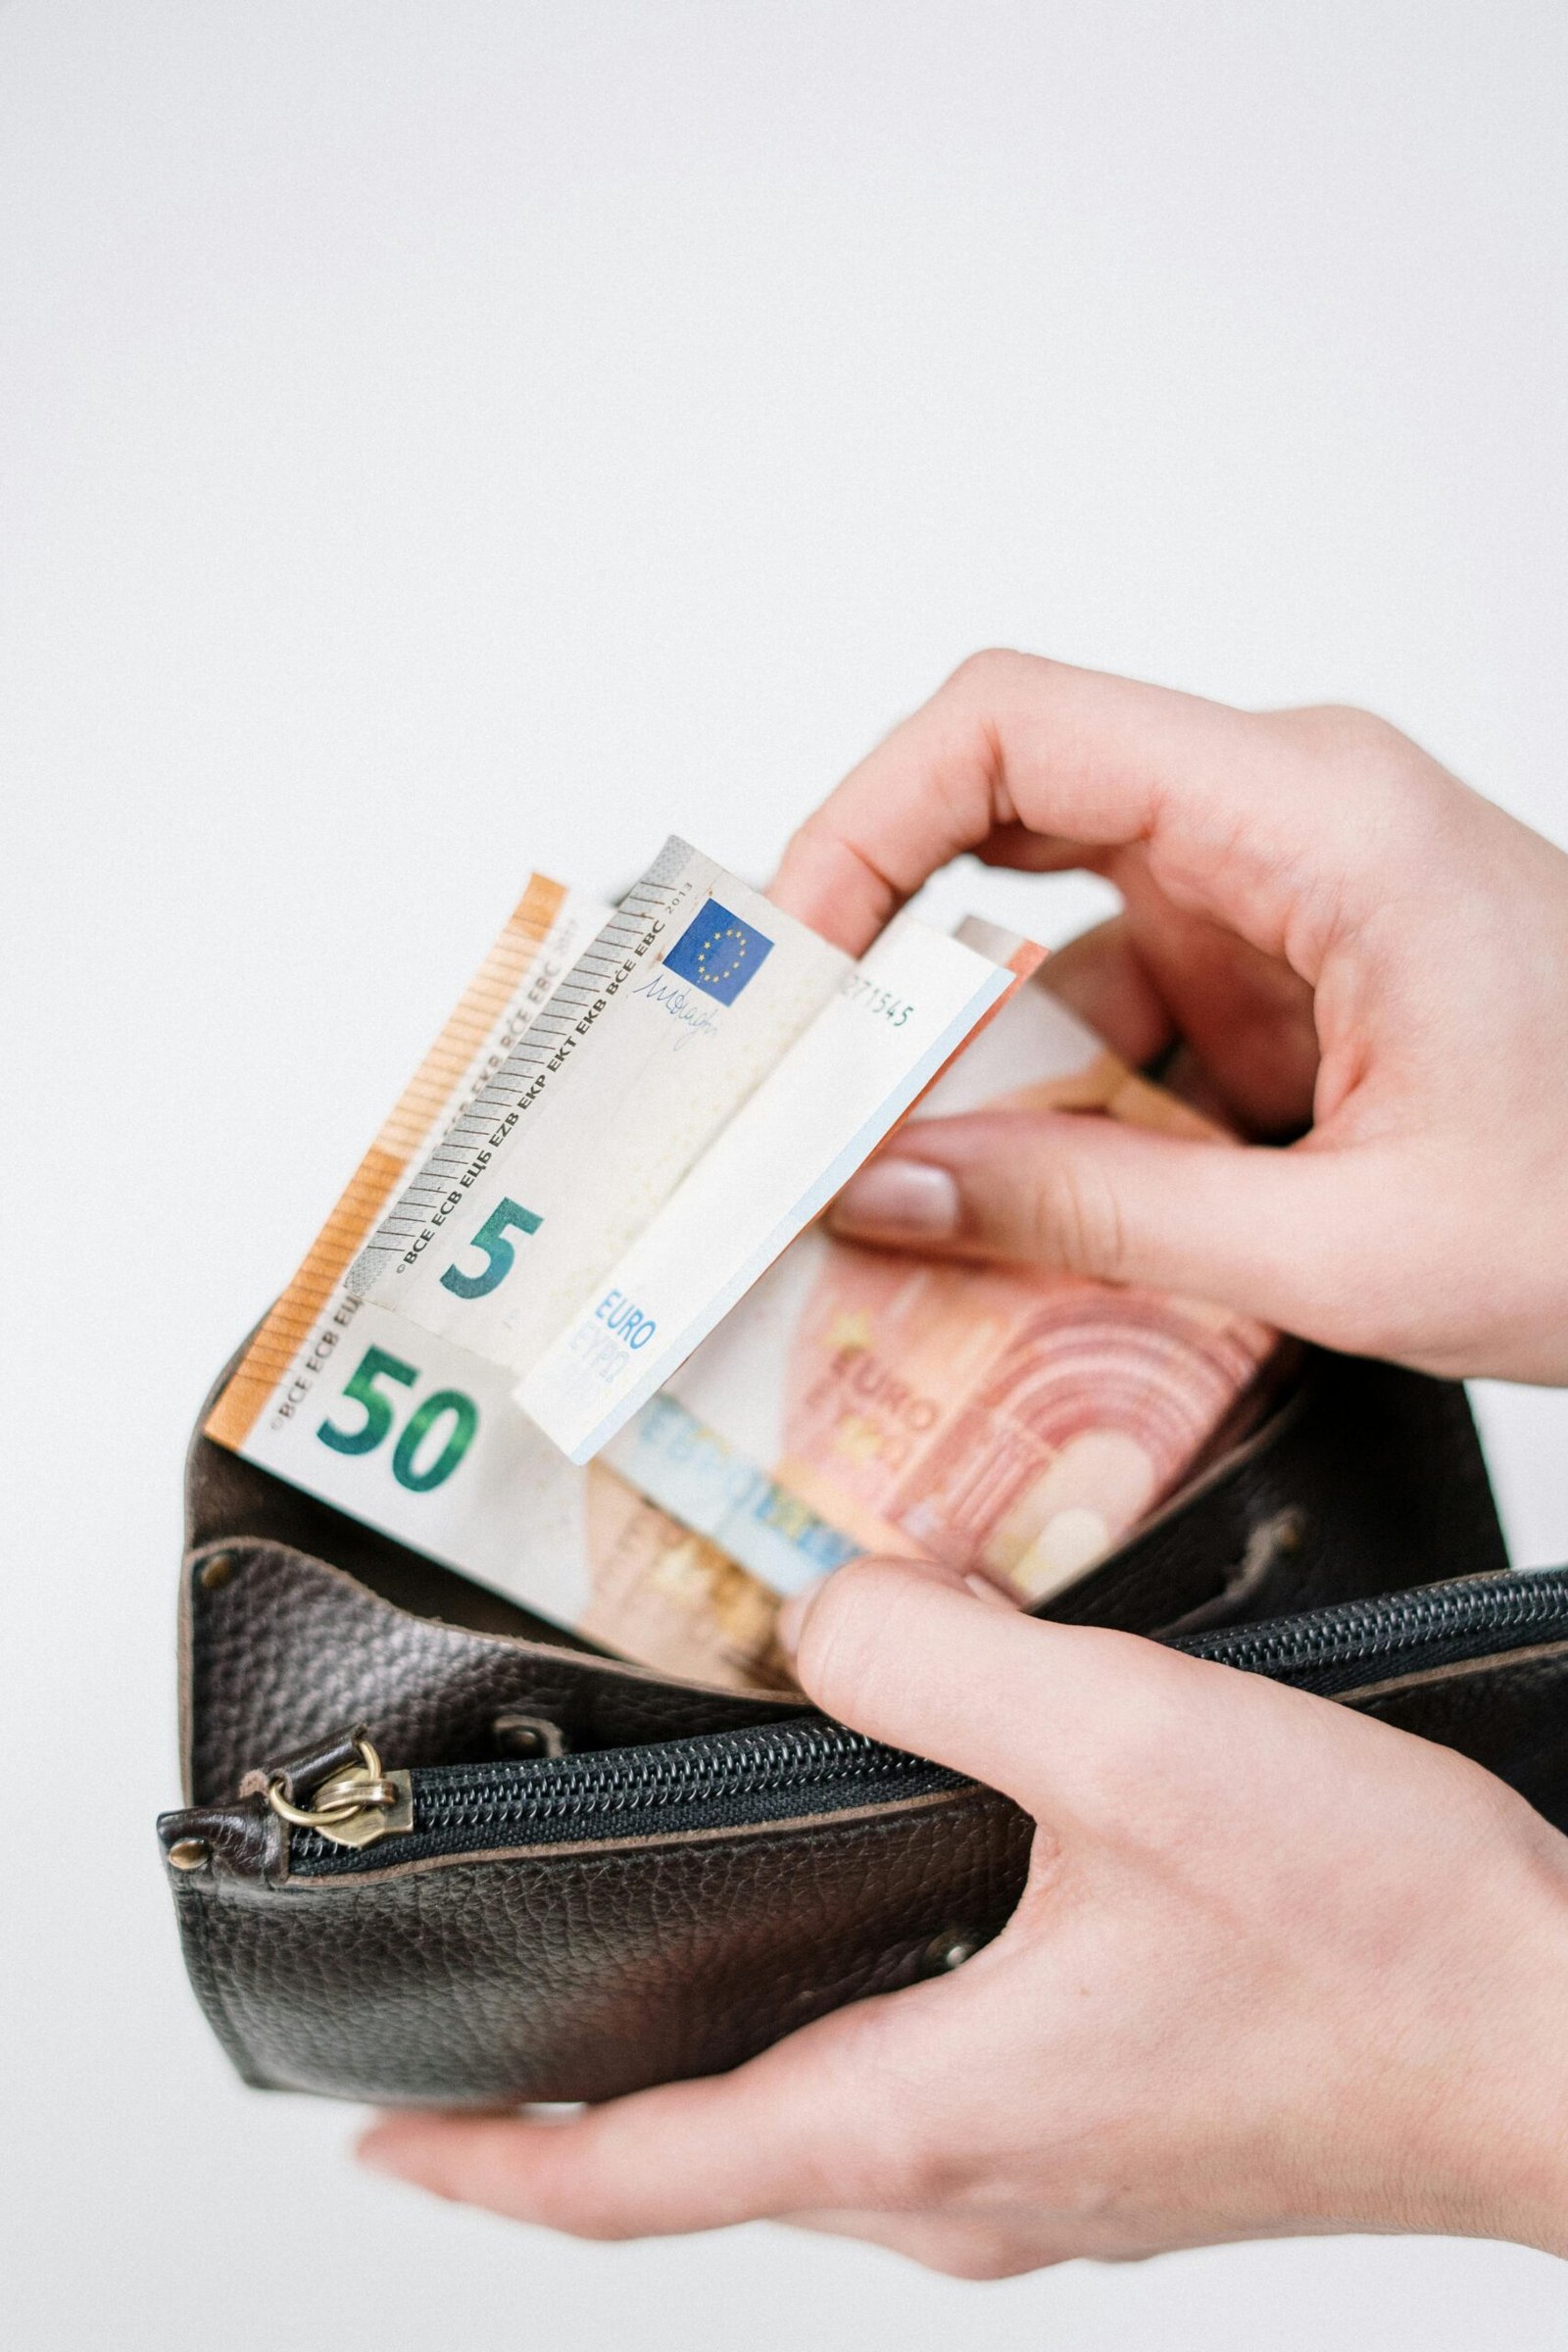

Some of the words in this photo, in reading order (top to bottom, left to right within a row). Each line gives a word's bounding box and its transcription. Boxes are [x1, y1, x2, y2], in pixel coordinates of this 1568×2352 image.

[431, 1191, 463, 1227] ECB
[488, 1111, 519, 1148] EZB
[516, 1074, 547, 1109] EKP
[546, 1036, 576, 1072] EKT
[574, 999, 607, 1035] EKB
[633, 919, 665, 956] EBC
[664, 881, 694, 914] 2013
[439, 1196, 545, 1300] 5
[305, 1330, 340, 1373] ECB
[594, 1288, 658, 1350] EURO
[316, 1342, 479, 1494] 50
